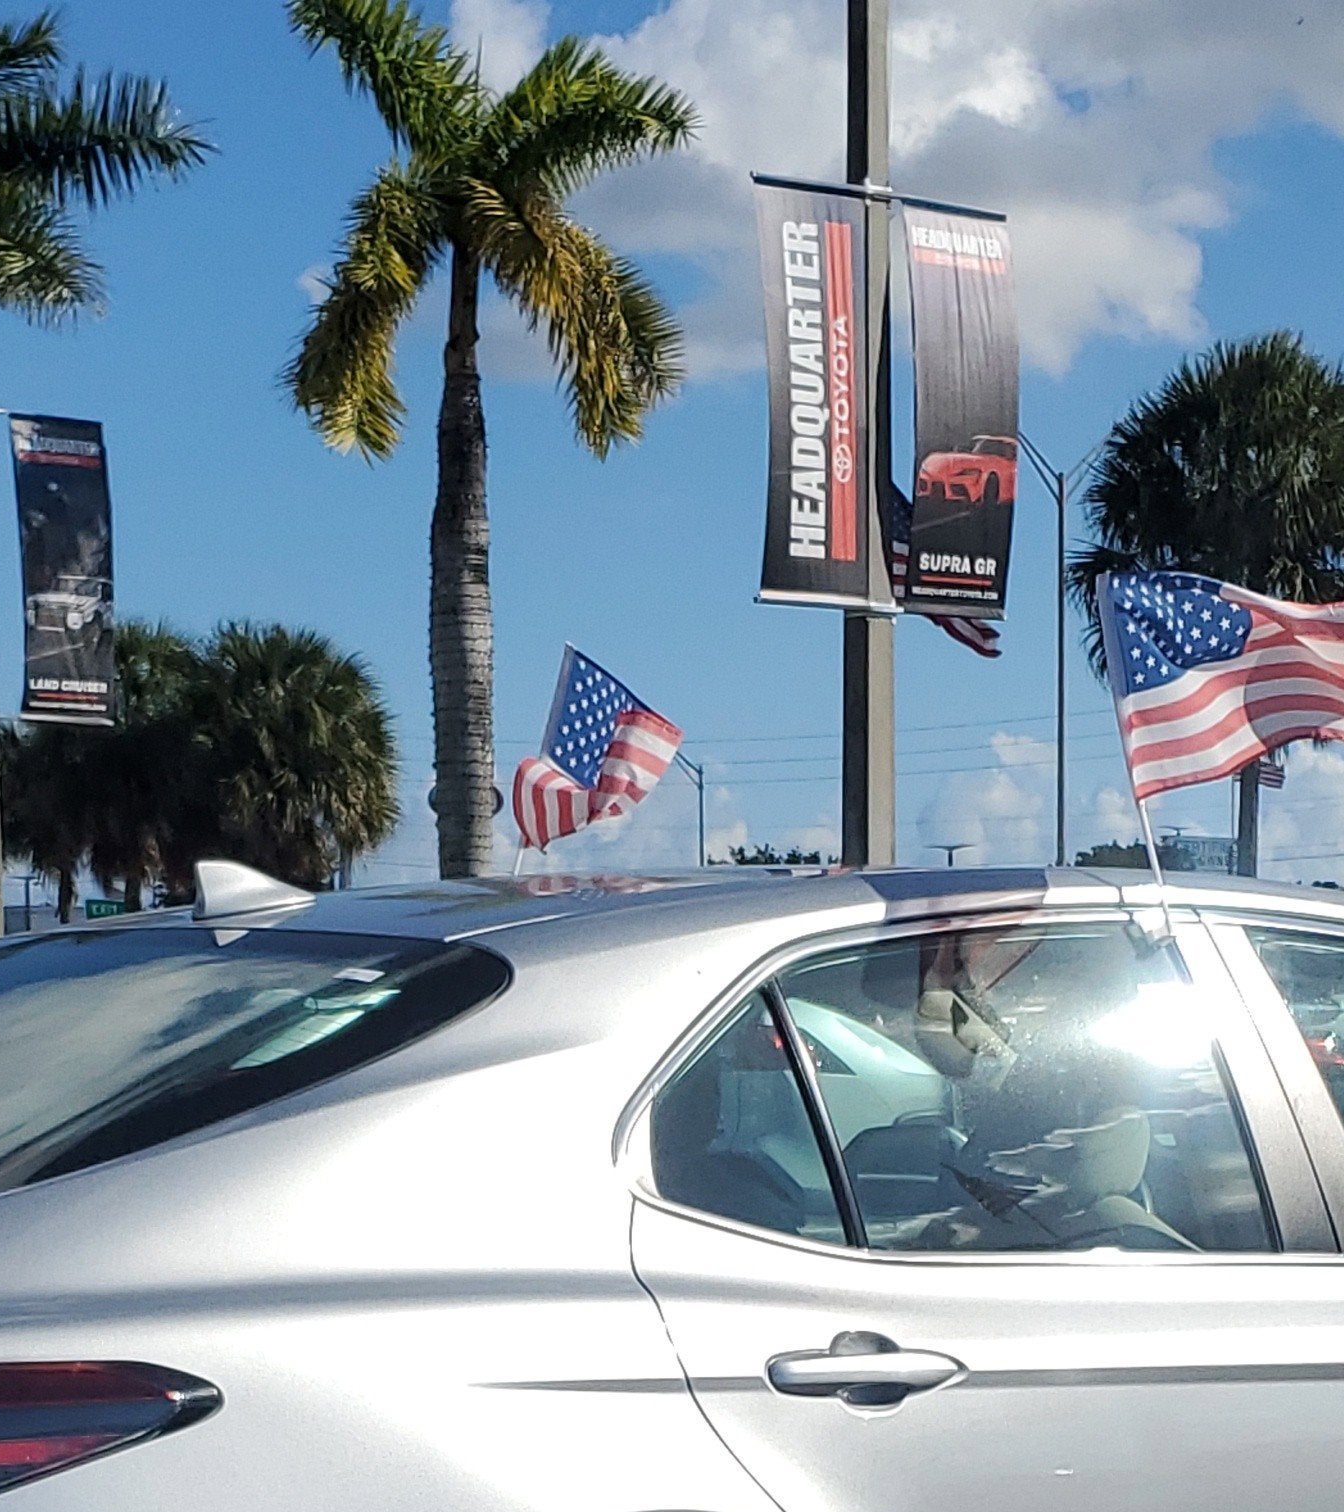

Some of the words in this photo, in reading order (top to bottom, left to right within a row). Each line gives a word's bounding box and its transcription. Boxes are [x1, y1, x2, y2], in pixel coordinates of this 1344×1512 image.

[910, 225, 1003, 260] HEADQUARTER
[782, 220, 830, 560] HEADQUARTER
[830, 314, 850, 442] TOYOTA
[919, 552, 972, 575] SUPRA
[974, 557, 997, 577] GR
[29, 677, 59, 691] LAND
